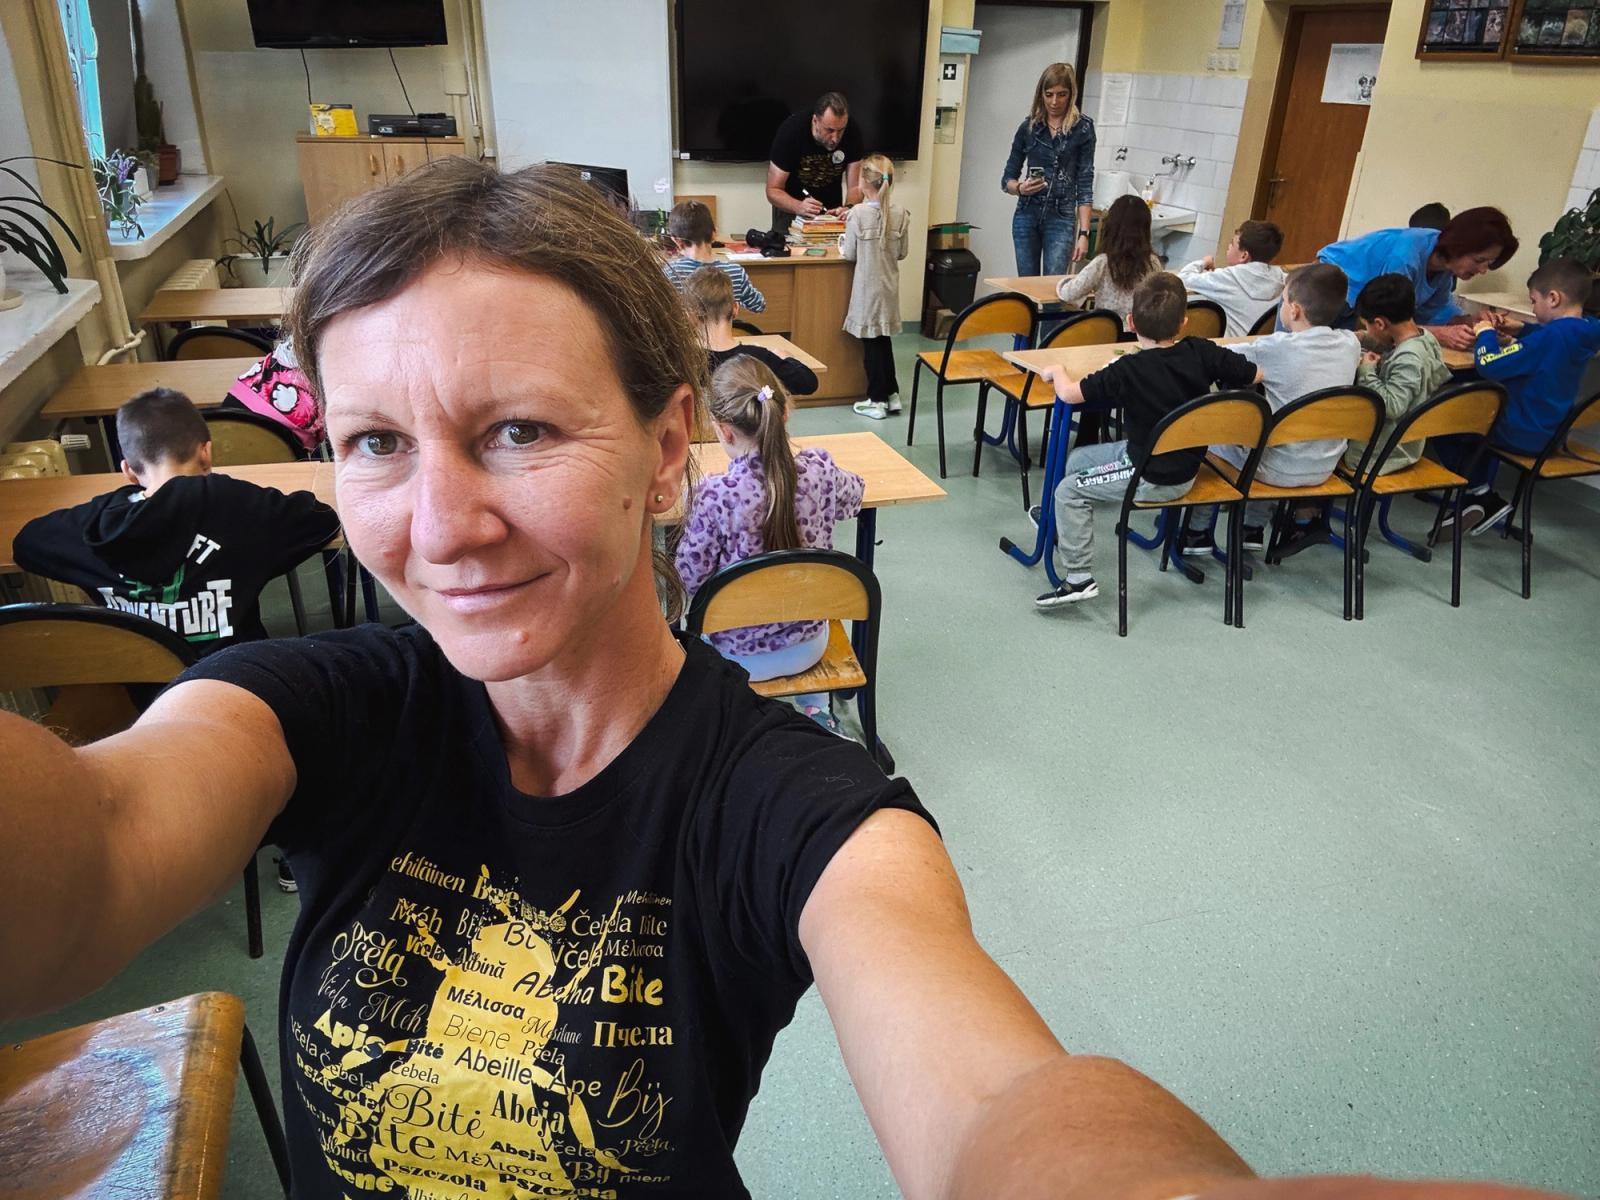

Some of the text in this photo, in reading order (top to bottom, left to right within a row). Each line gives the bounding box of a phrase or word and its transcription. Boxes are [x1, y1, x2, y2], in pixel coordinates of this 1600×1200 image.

[443, 1014, 511, 1050] Biene
[389, 1056, 440, 1085] Čebela
[454, 1046, 532, 1085] Abeille
[547, 1064, 602, 1106] Ape
[490, 1089, 566, 1138] Abeja
[490, 1140, 547, 1162] Abeja
